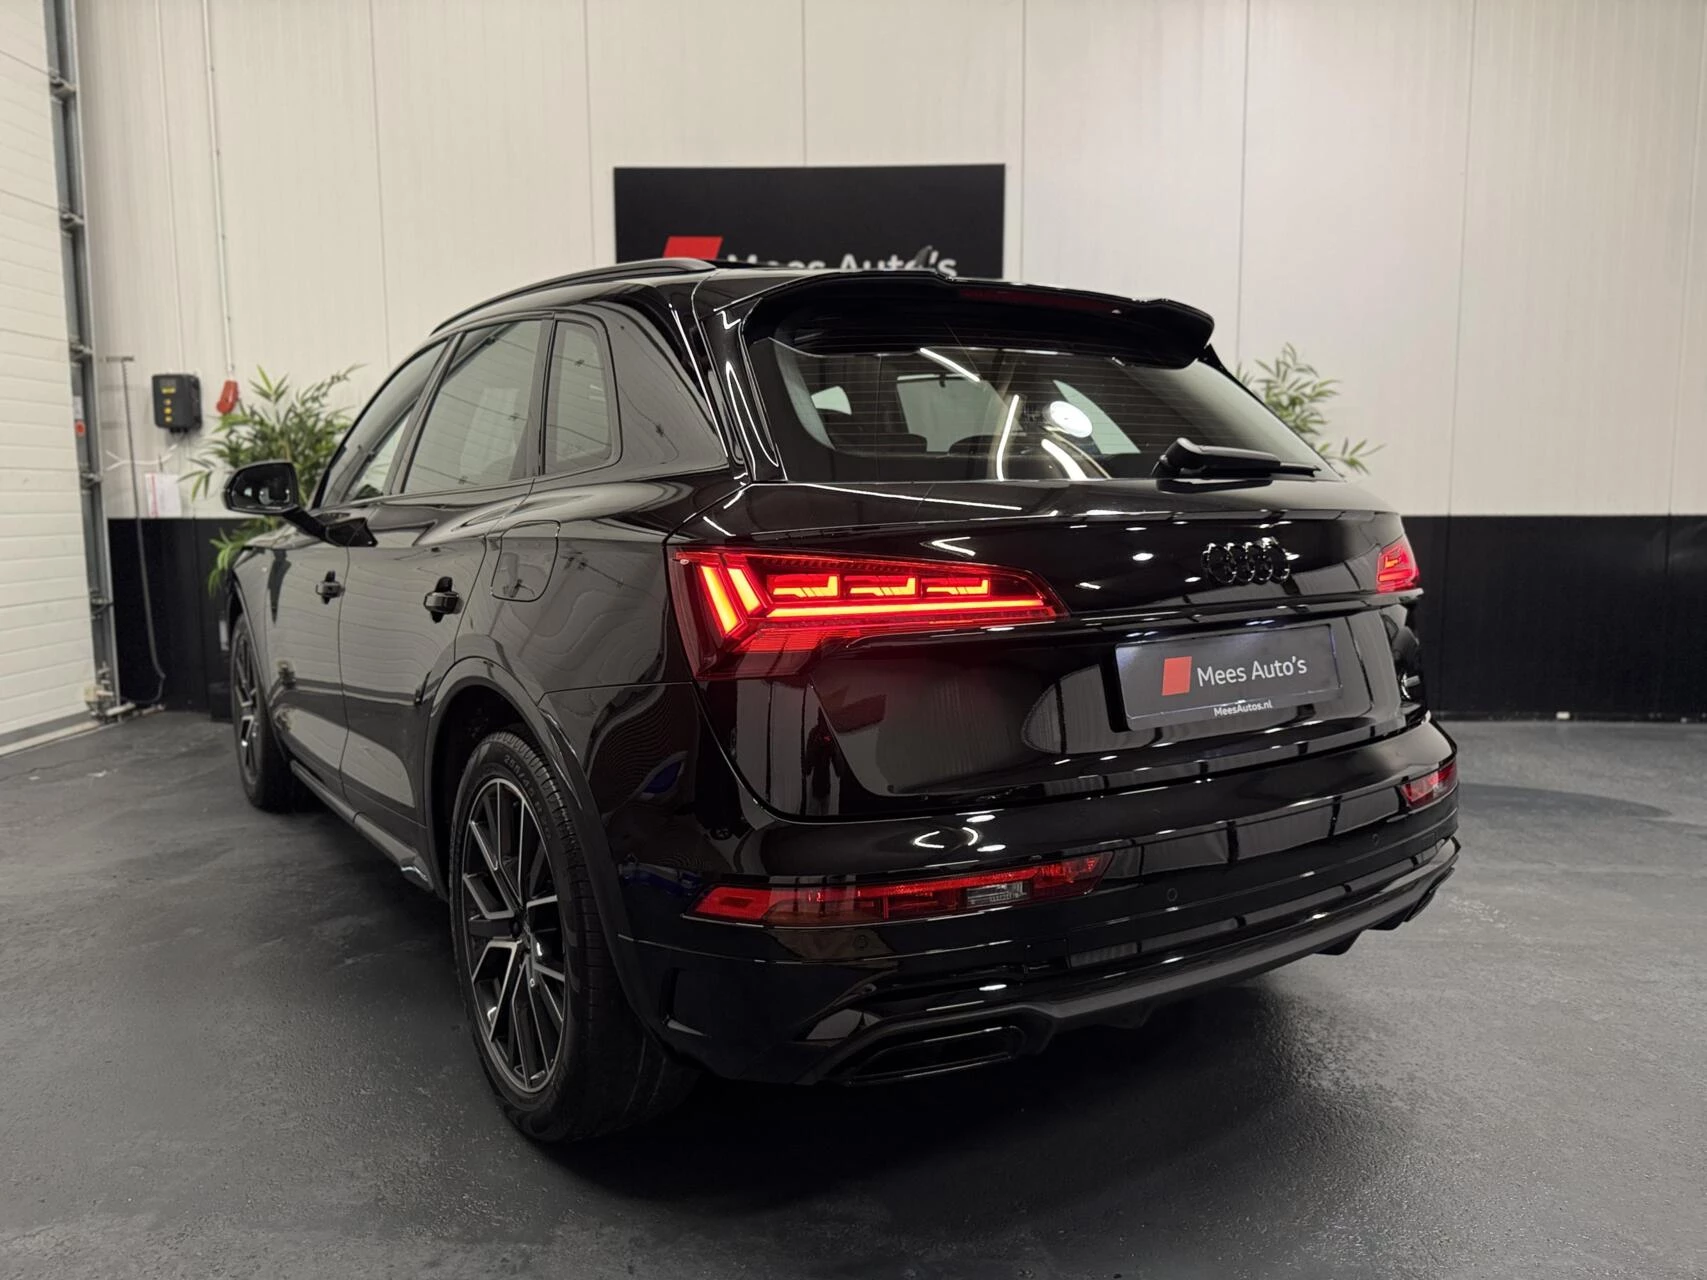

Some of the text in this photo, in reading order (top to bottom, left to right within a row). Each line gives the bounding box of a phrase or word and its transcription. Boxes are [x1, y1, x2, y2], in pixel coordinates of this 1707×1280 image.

[1197, 656, 1307, 687] Mees Auto's
[1213, 700, 1272, 716] MeesAutos.nl
